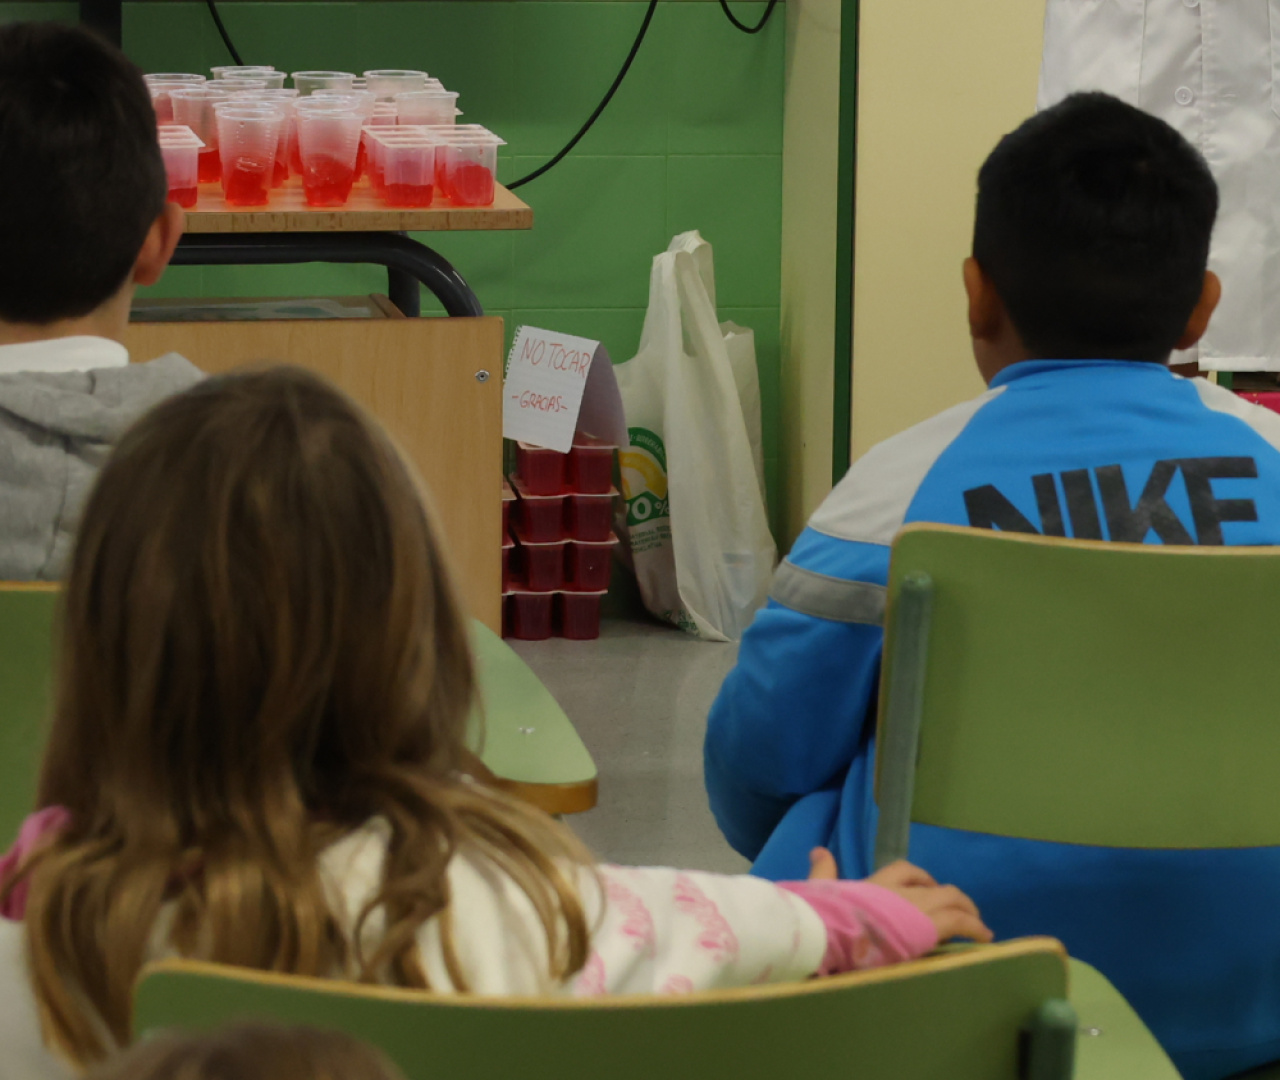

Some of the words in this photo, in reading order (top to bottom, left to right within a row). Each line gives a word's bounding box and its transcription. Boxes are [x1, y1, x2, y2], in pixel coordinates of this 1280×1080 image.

[520, 337, 545, 367] NO
[548, 343, 591, 378] TOCAR
[963, 456, 1259, 547] NIKE
